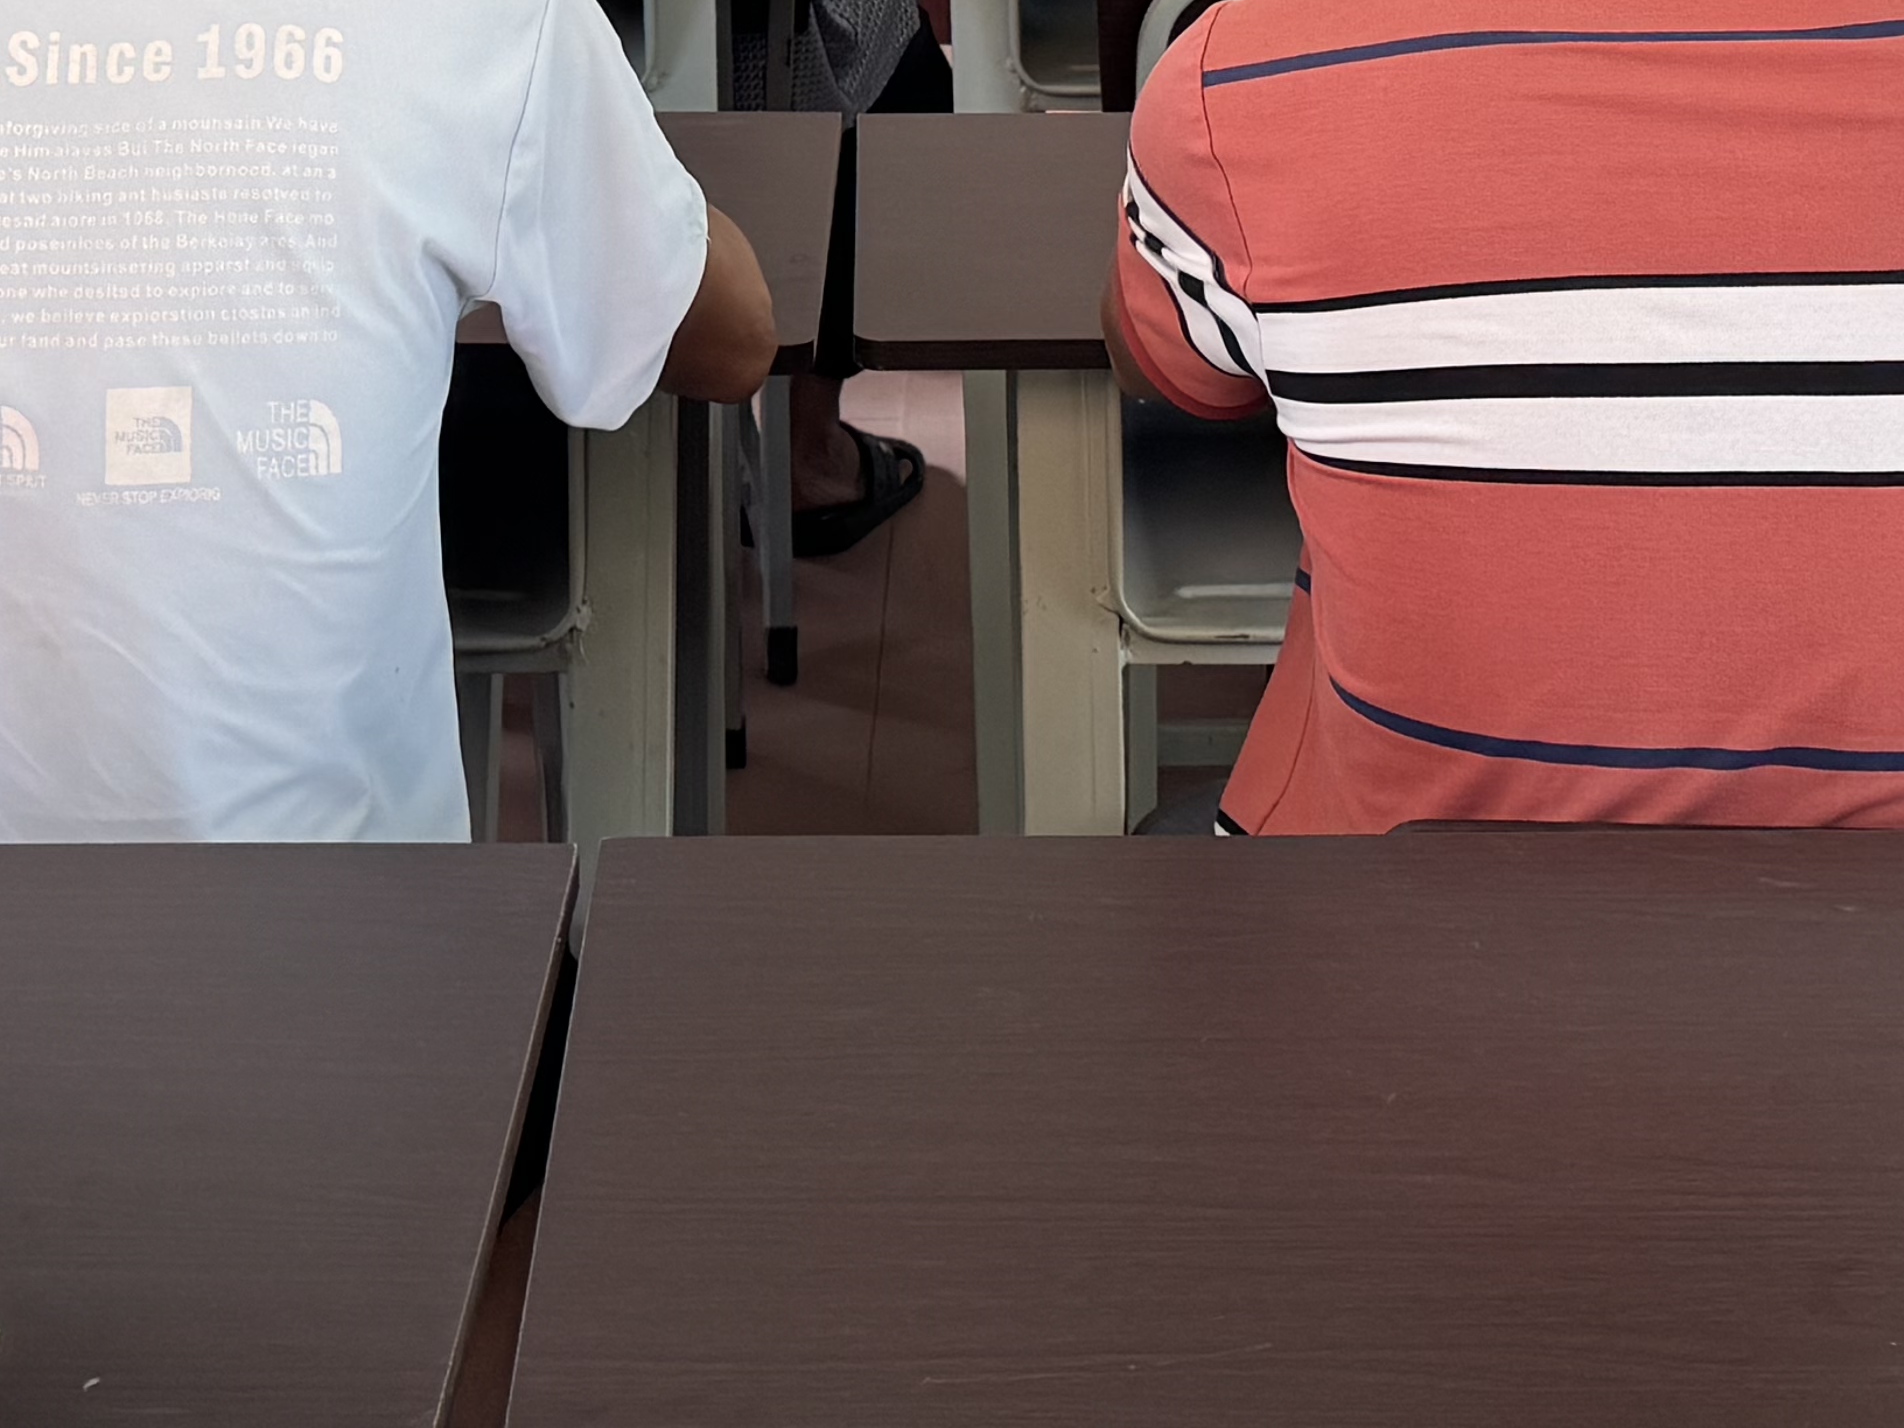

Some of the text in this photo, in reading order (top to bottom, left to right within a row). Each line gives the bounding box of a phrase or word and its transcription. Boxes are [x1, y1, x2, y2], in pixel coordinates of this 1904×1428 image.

[195, 22, 344, 84] 1966
[190, 138, 240, 154] North
[245, 139, 288, 154] Face
[27, 165, 78, 181] North
[174, 210, 209, 225] The
[264, 209, 305, 225] Face
[141, 234, 171, 250] the
[304, 233, 338, 249] And
[64, 331, 98, 348] and
[266, 399, 309, 423] THE
[115, 428, 161, 443] MUSIC
[236, 427, 308, 455] MUSIC
[256, 453, 309, 481] FACE
[121, 490, 158, 505] STOP
